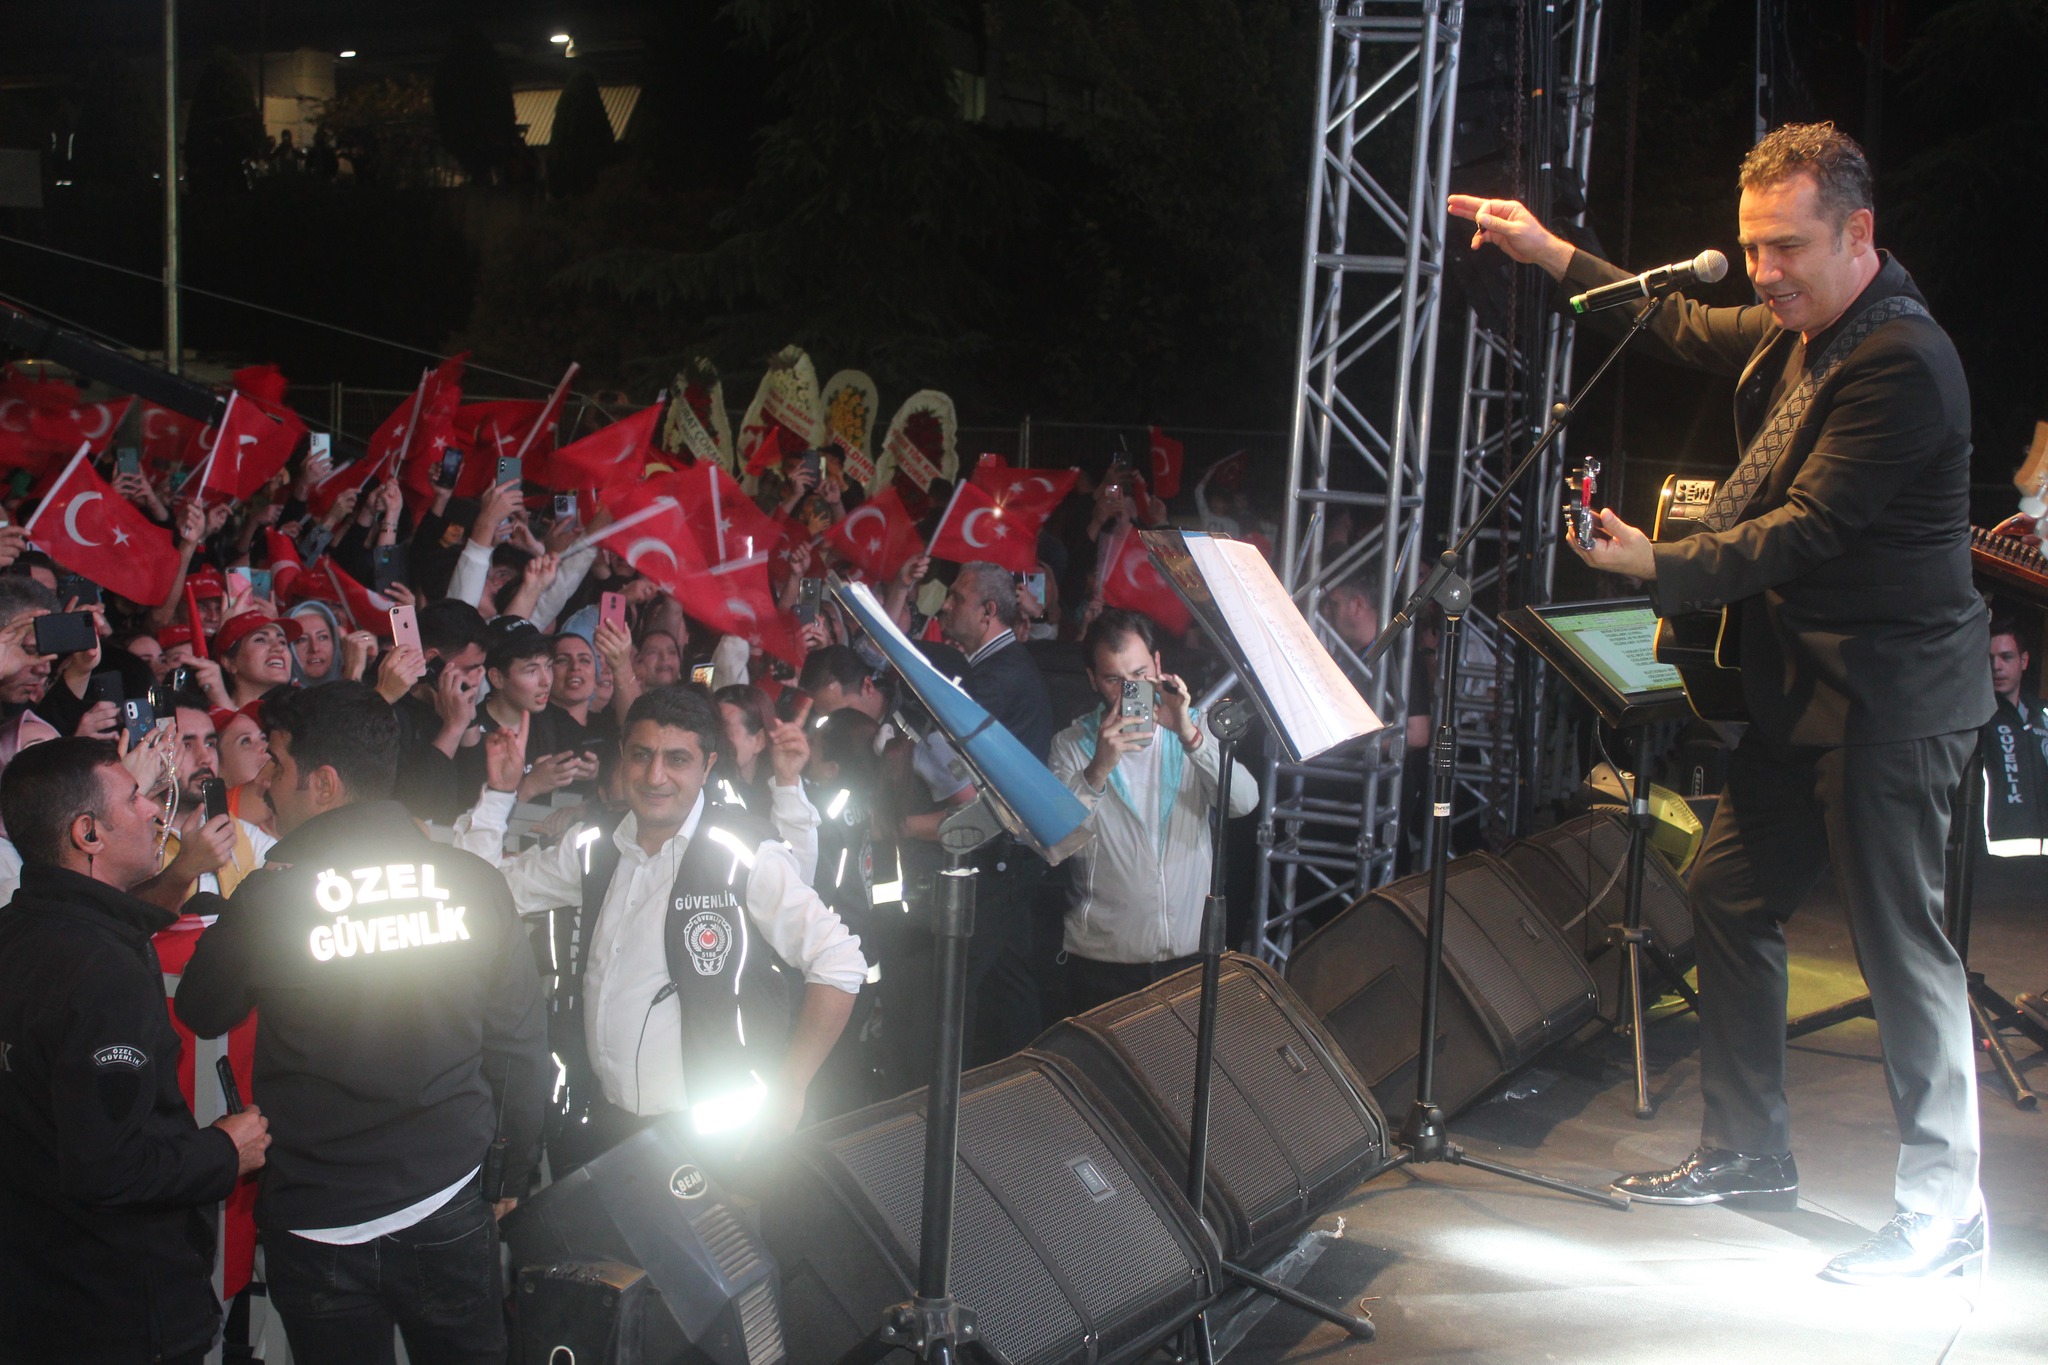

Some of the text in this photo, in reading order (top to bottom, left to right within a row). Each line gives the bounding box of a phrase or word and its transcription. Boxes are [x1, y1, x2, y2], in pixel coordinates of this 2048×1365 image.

[315, 864, 450, 913] ÖZEL
[675, 890, 738, 911] GÜVENLİK
[309, 901, 471, 962] GÜVENLİK
[101, 1053, 141, 1066] GÜVENLİK
[112, 1047, 133, 1056] ÖZEL
[676, 1170, 704, 1193] BEAM
